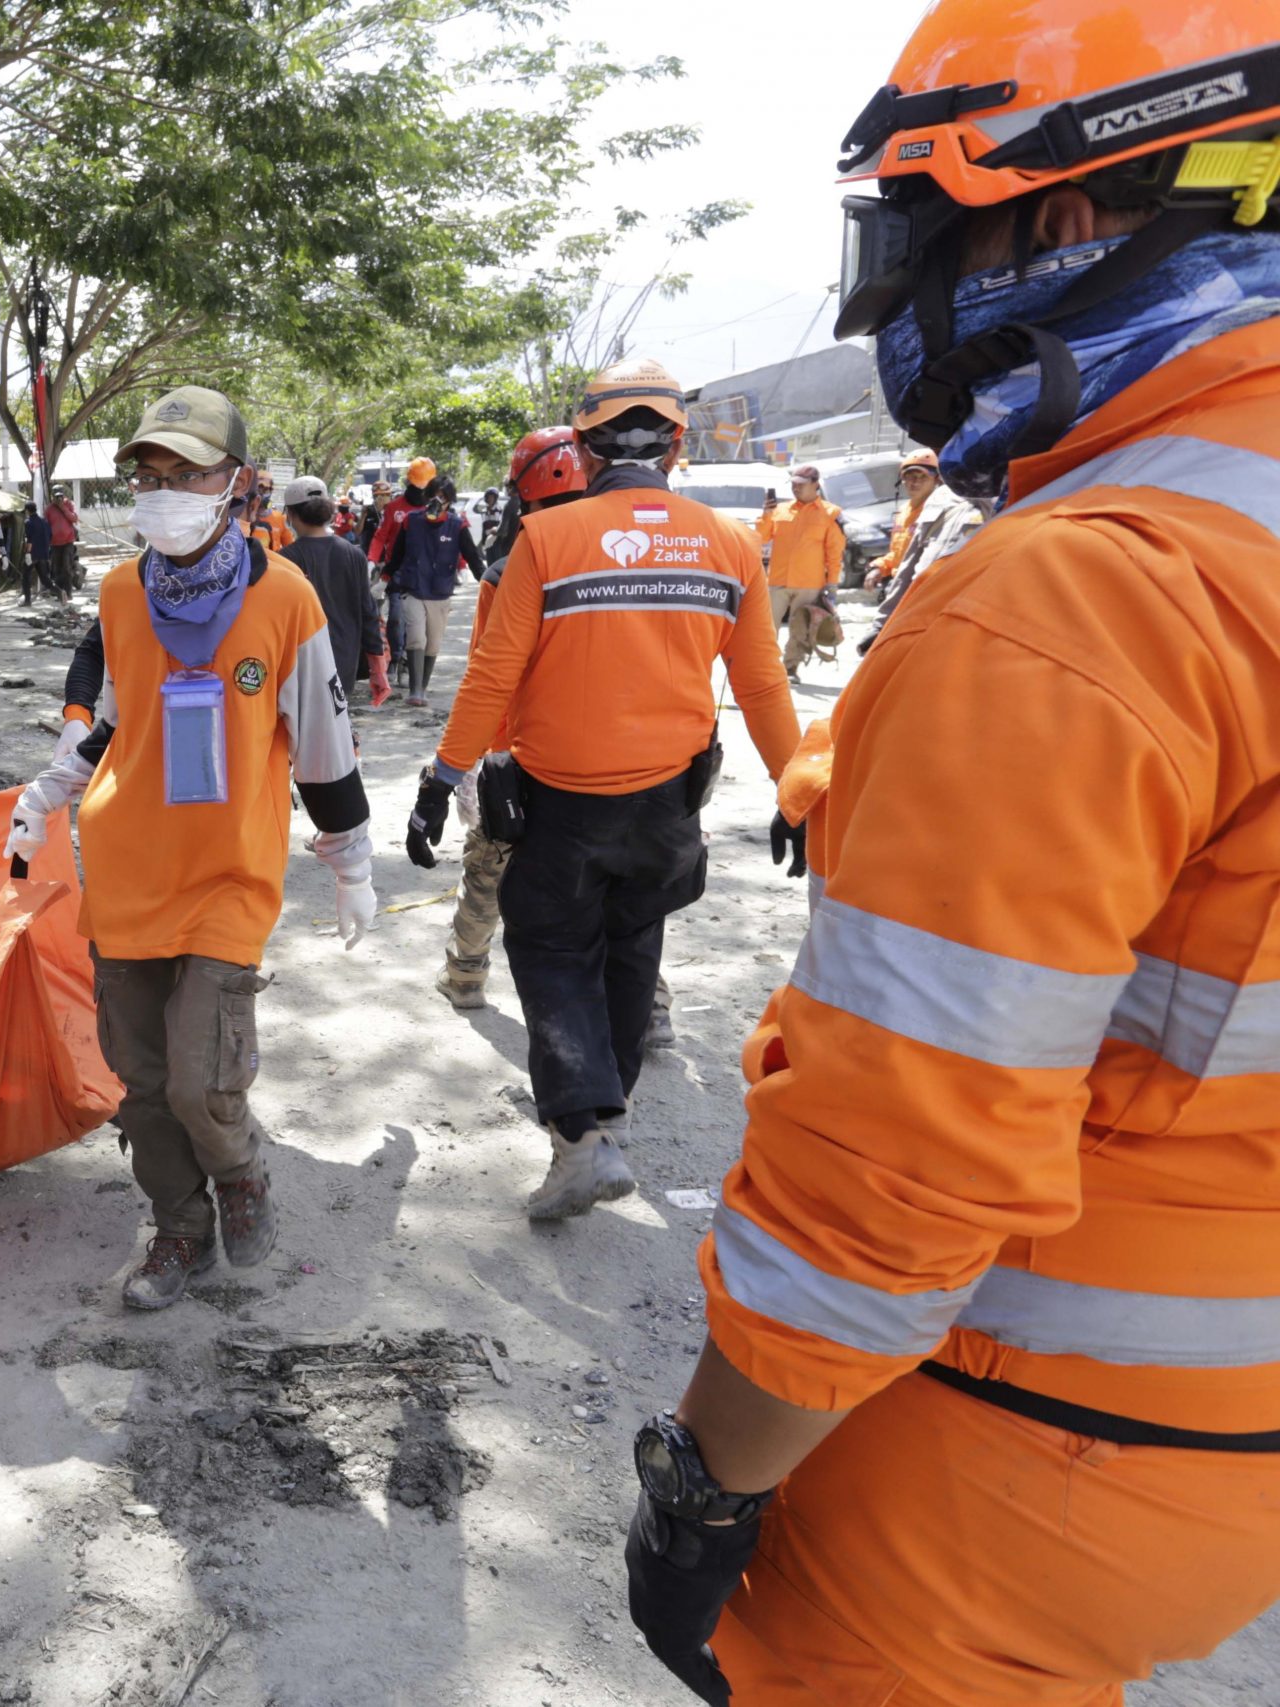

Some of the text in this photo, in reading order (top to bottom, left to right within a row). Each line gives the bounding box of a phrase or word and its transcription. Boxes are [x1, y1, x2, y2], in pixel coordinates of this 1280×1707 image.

[1093, 75, 1241, 139] MSA
[898, 142, 931, 159] MSA
[653, 534, 709, 548] Rumah
[653, 549, 700, 563] Zakat
[576, 581, 729, 604] www.rumahzakat.org
